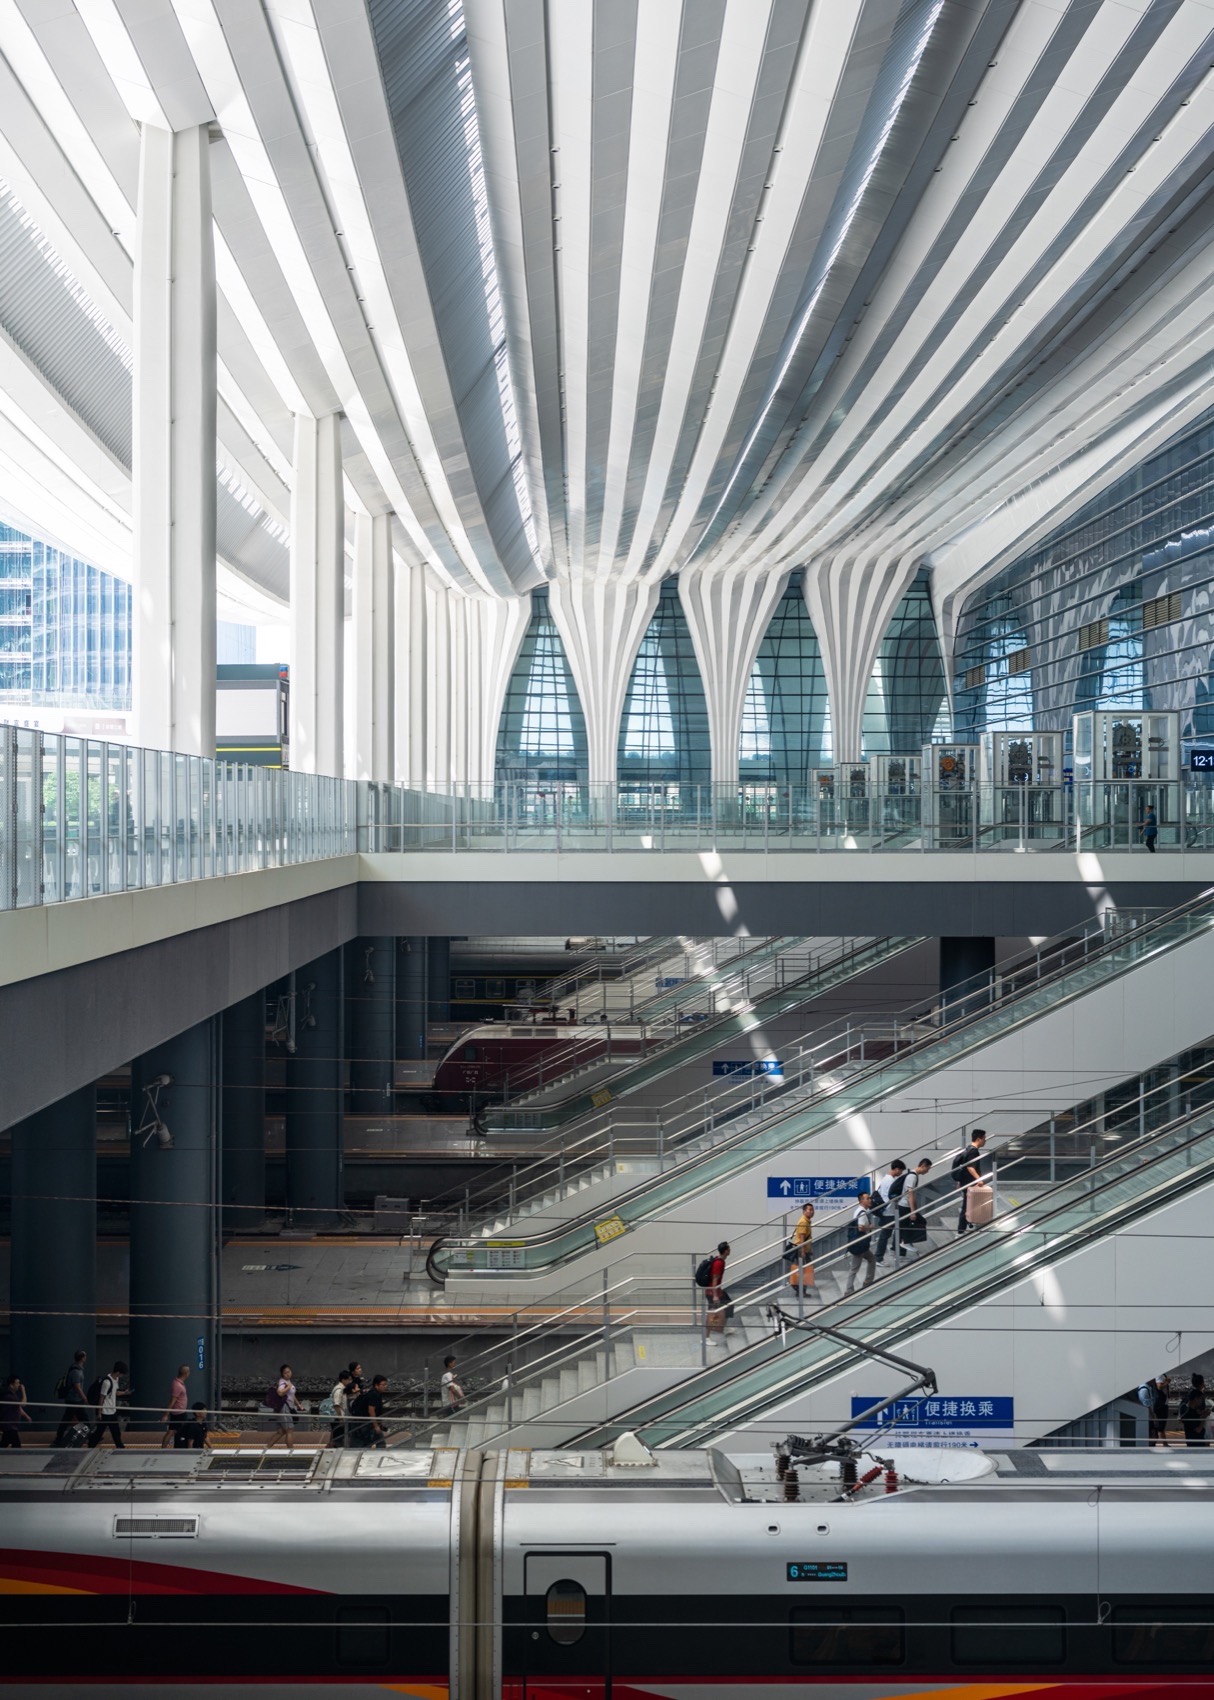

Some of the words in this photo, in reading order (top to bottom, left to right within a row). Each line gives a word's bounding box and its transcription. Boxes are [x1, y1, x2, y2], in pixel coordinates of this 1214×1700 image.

[814, 1179, 858, 1190] 便捷换乘
[924, 1400, 994, 1417] 便捷换乘
[790, 1565, 799, 1578] 6
